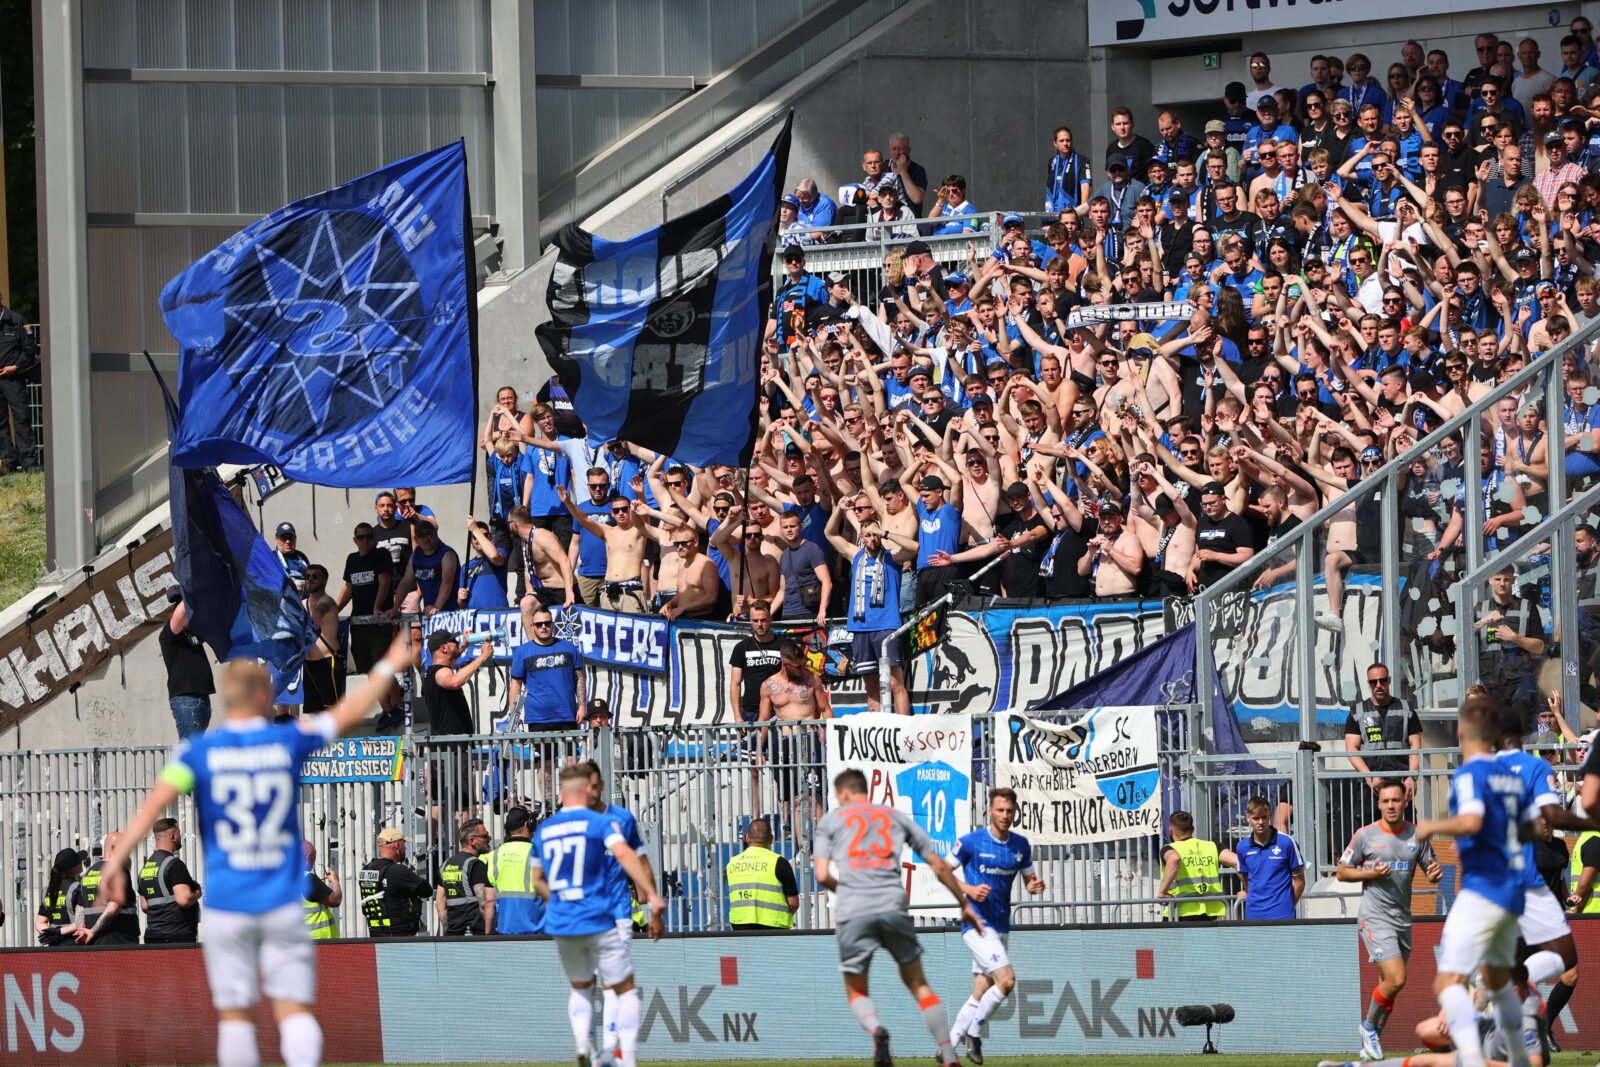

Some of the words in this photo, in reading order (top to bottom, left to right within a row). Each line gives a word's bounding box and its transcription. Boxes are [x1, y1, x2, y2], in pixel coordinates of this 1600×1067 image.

[834, 725, 906, 763] TAUSCHE
[1112, 716, 1131, 743] SC
[308, 741, 345, 758] NAPS
[348, 741, 357, 756] &
[360, 740, 396, 756] WEED
[1074, 747, 1139, 775] PADERBORN
[917, 769, 951, 781] PADERBORN
[1010, 774, 1034, 790] DARF
[1053, 767, 1076, 791] BITTE
[1117, 781, 1134, 805] 07
[211, 772, 294, 852] 32
[921, 789, 947, 833] 10
[1051, 796, 1106, 835] TRIKOT
[844, 813, 894, 859] 23
[543, 836, 587, 891] 27
[722, 1012, 758, 1043] NX
[1138, 1007, 1175, 1038] NX
